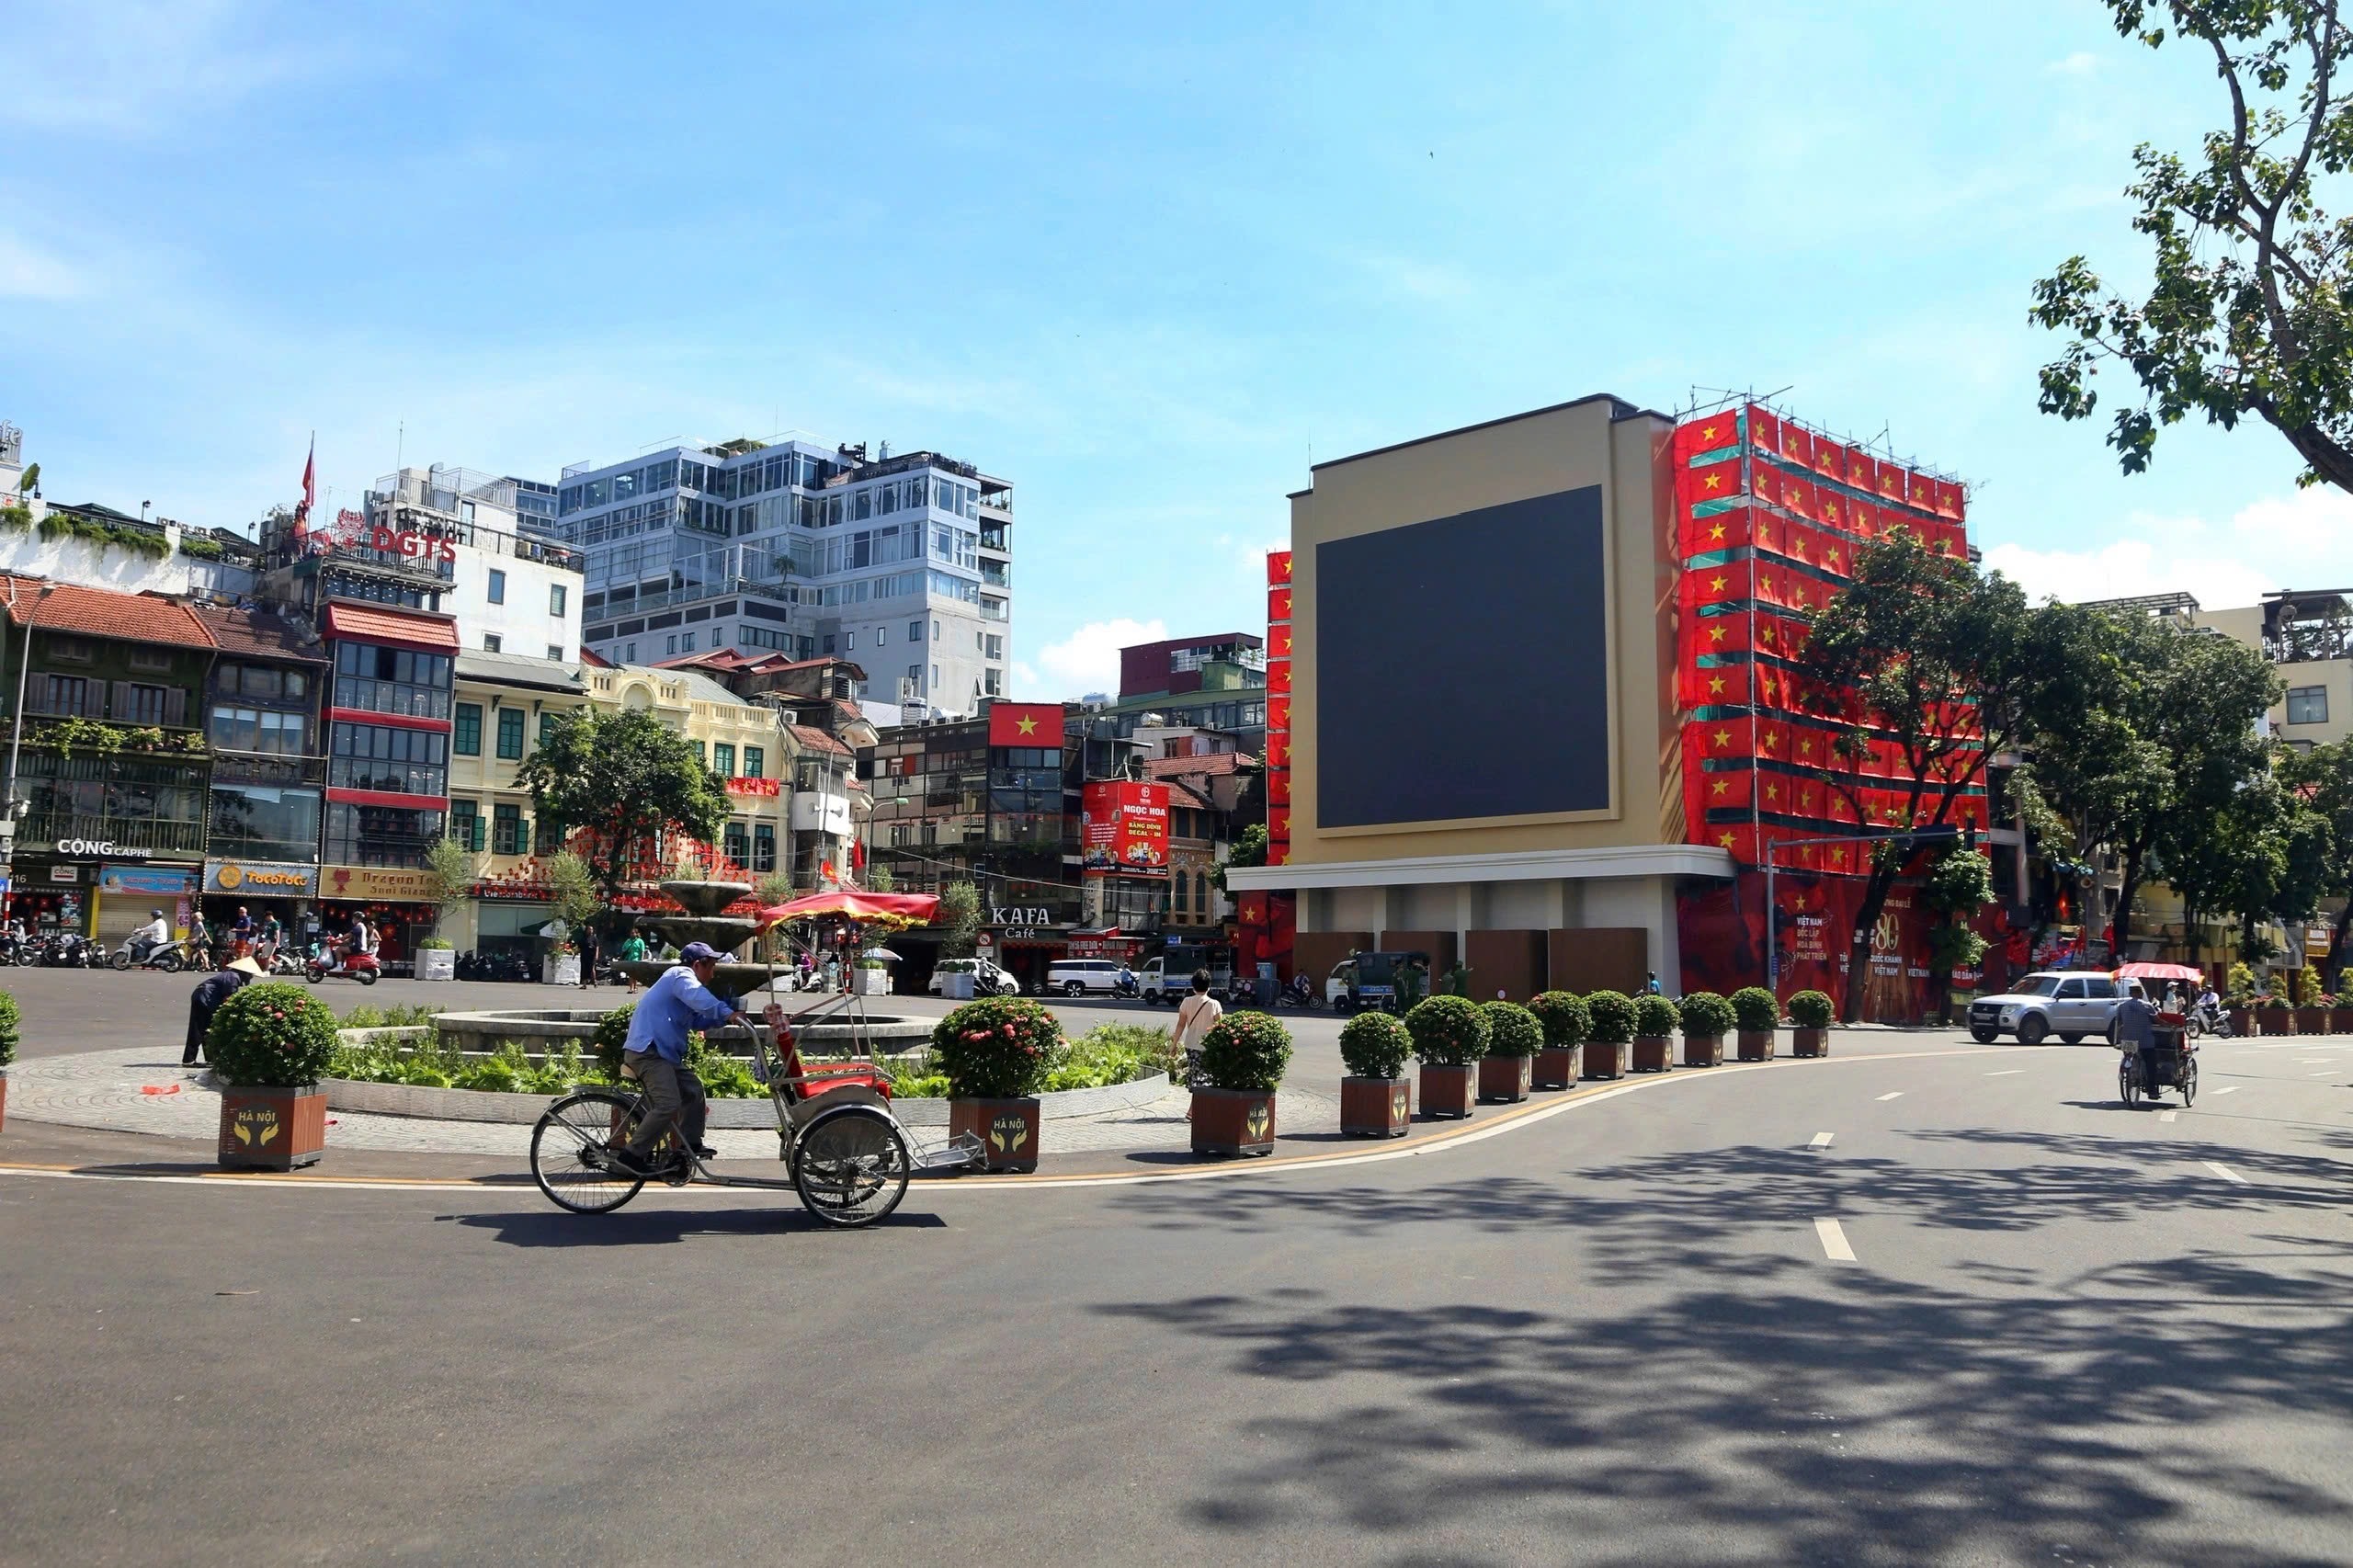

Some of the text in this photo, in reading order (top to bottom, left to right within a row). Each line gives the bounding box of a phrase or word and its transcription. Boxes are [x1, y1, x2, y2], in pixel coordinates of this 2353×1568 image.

[0, 419, 22, 445] fe
[372, 526, 456, 562] DGTS
[1123, 804, 1166, 816] NGỌC HOA
[58, 837, 113, 856] CỘNG
[363, 872, 414, 885] Dragon
[991, 907, 1051, 926] KAFA
[1005, 927, 1035, 938] Café
[1876, 913, 1899, 949] 80
[239, 1110, 276, 1124] HÀ NỘI
[994, 1118, 1024, 1131] HÀ NỘI
